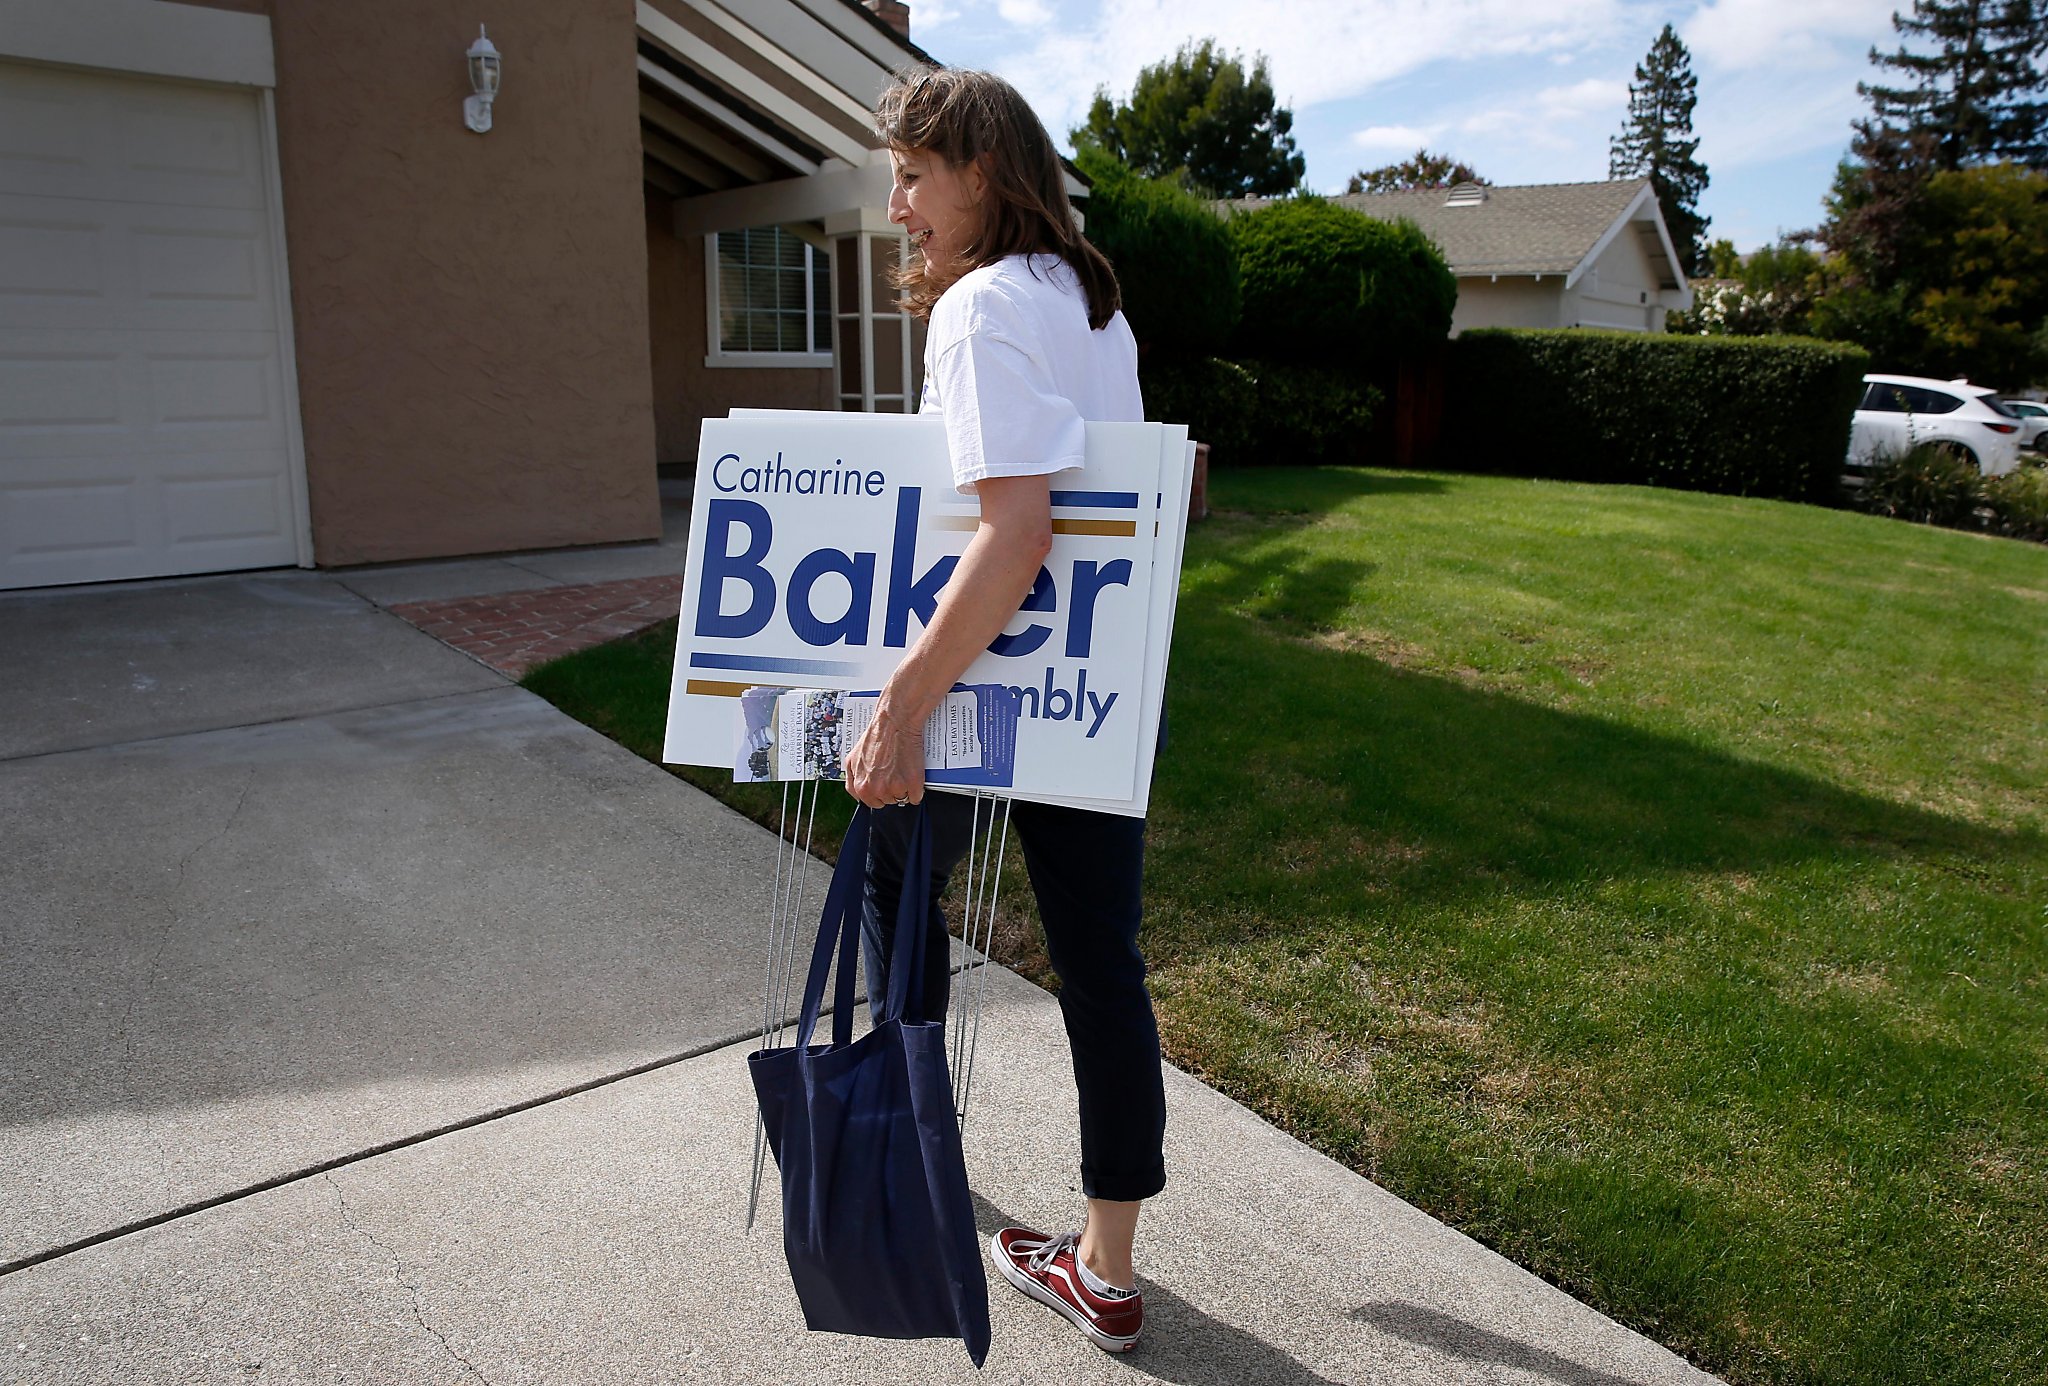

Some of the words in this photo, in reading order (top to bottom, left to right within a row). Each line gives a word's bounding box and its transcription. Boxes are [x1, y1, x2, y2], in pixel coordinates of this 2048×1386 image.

[712, 451, 885, 497] Catharine
[694, 486, 1133, 658] Baker
[846, 708, 854, 727] TIMES
[781, 721, 789, 754] Re-elect
